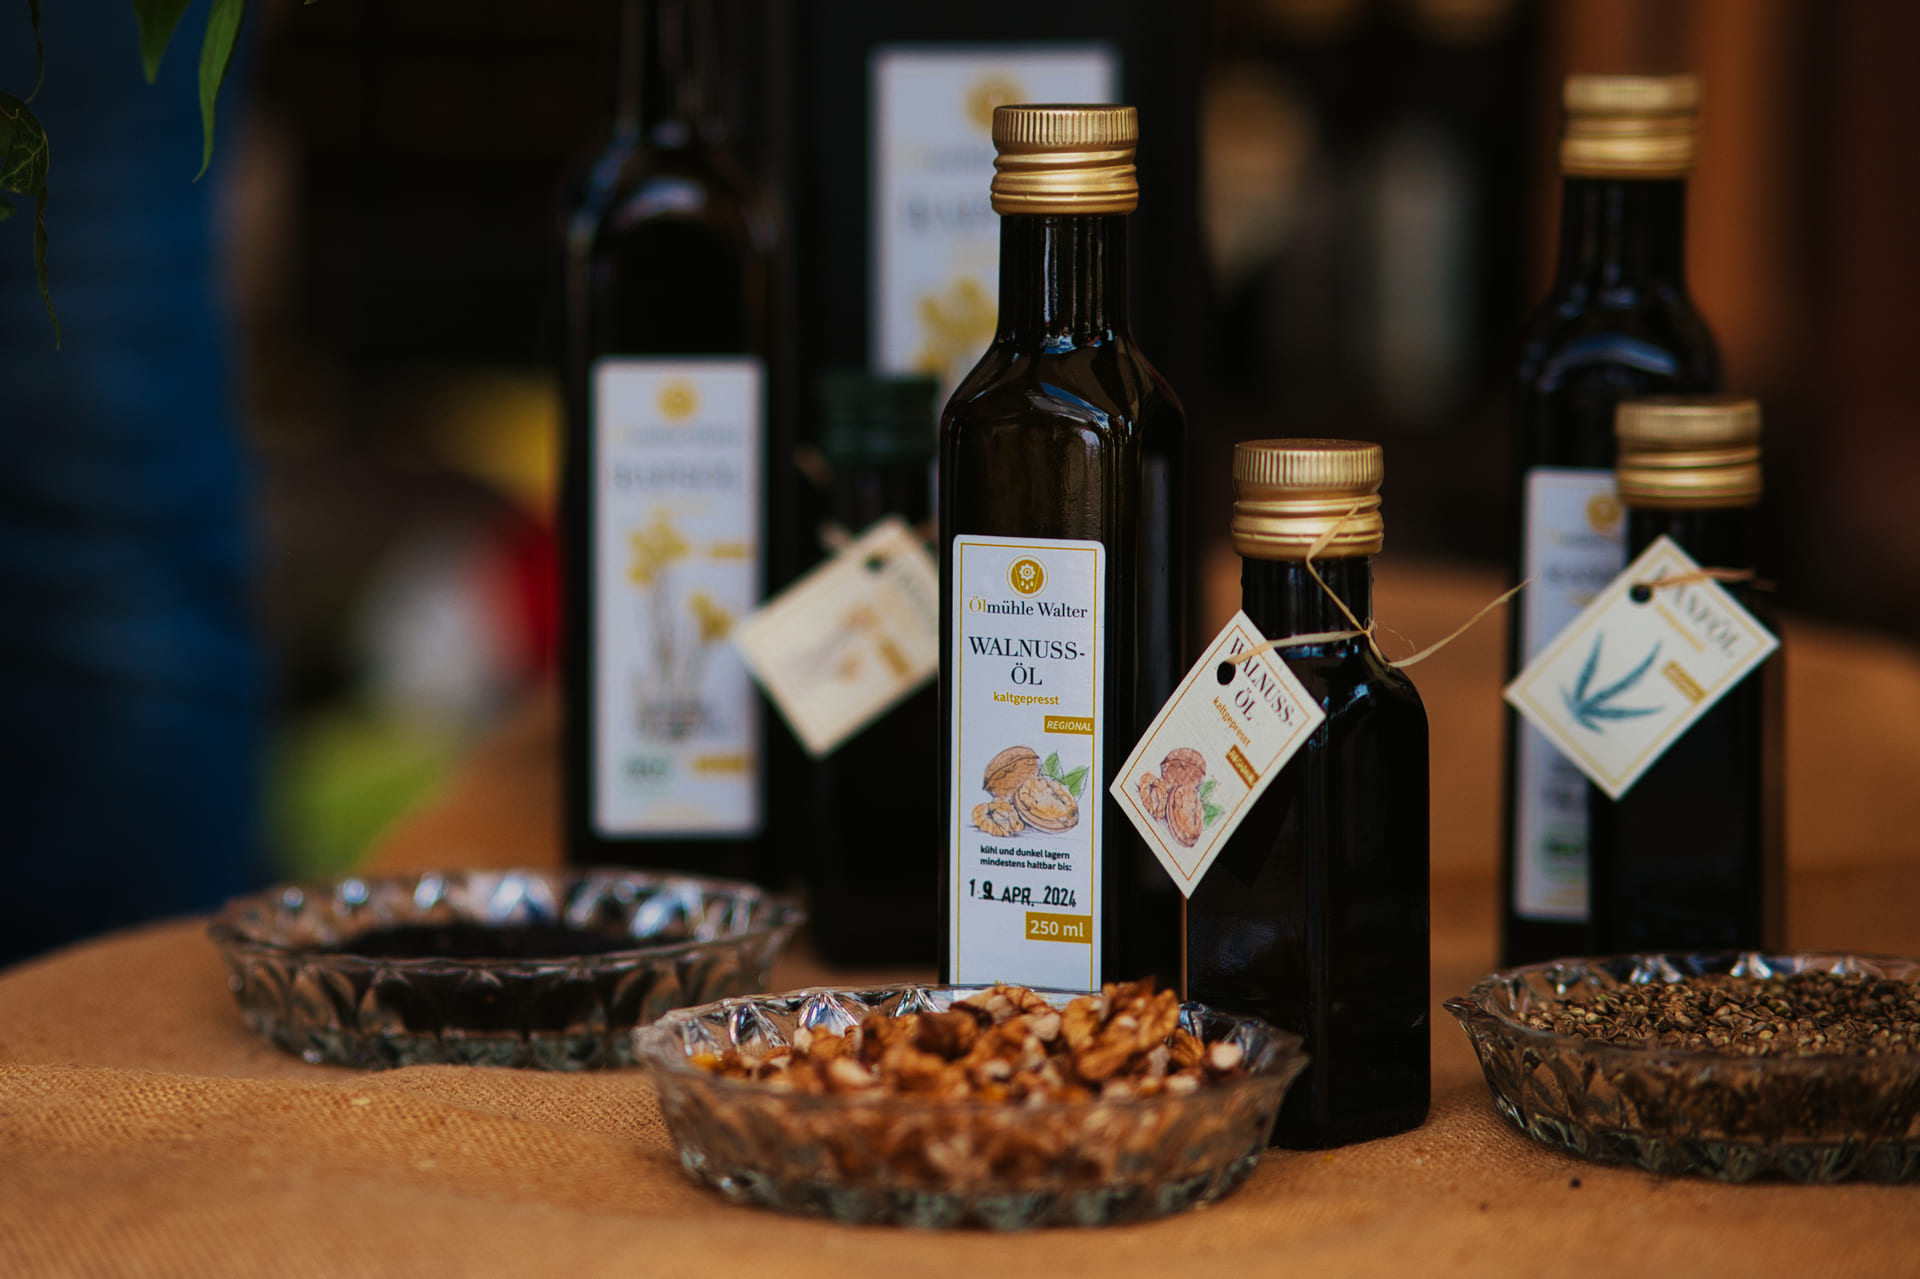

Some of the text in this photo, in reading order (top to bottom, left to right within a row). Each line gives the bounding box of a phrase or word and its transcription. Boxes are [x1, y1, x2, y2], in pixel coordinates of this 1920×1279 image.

[969, 596, 1088, 618] Ölmühle Walter
[968, 636, 1085, 660] WALNUSS-
[1011, 662, 1043, 685] ÖL
[993, 691, 1060, 706] kaltgepresst
[1234, 687, 1255, 722] ÖL
[1046, 720, 1093, 732] REGIONAL
[1212, 696, 1251, 748] kaltgepresst
[980, 845, 1070, 860] kühl und dunkel lagern
[980, 857, 1072, 871] mindestens haltbar bis:
[1001, 886, 1035, 907] APR.
[1044, 885, 1077, 908] 2024
[1030, 920, 1084, 937] 250 ml
